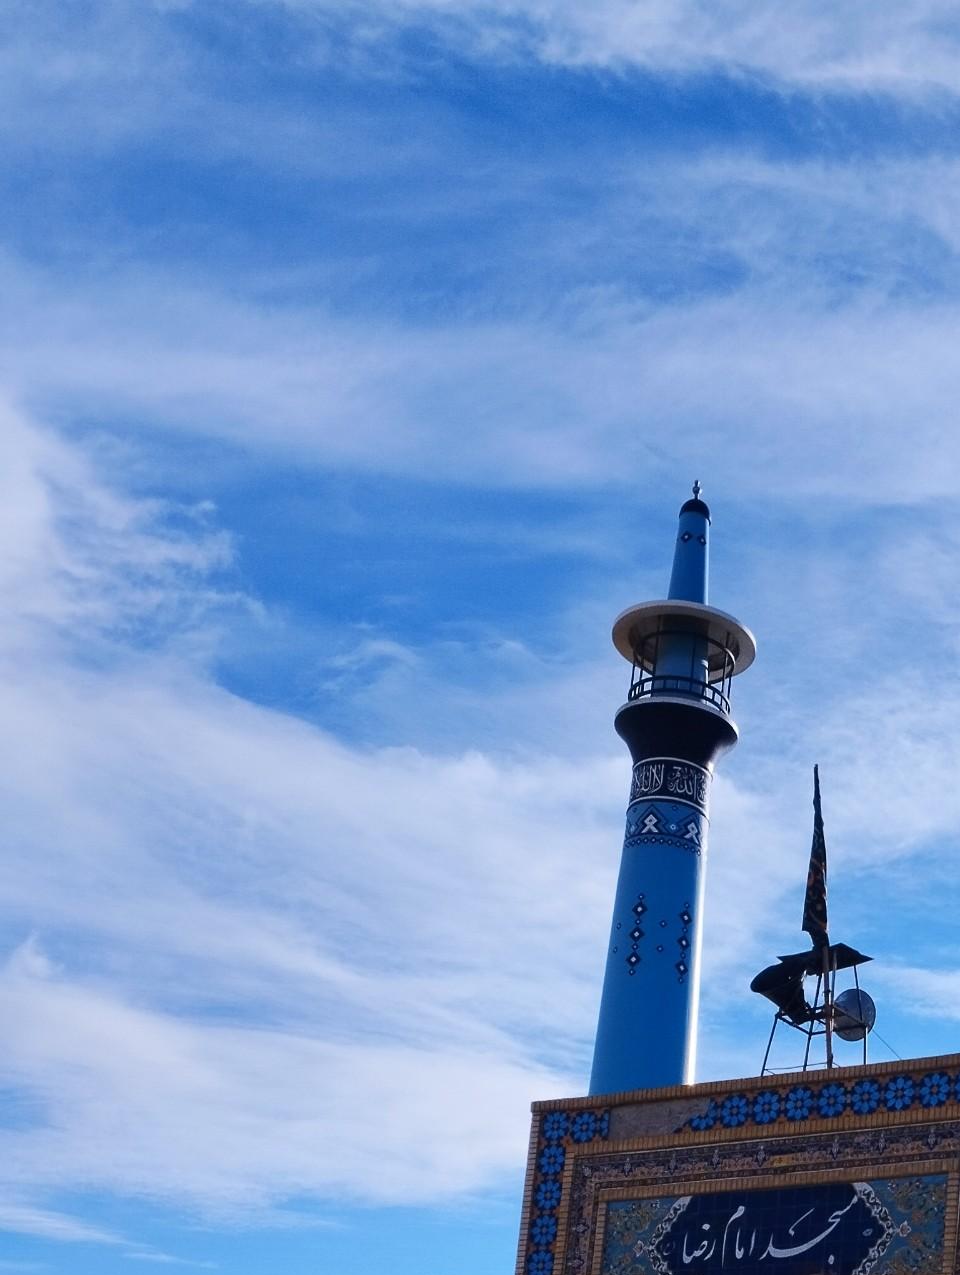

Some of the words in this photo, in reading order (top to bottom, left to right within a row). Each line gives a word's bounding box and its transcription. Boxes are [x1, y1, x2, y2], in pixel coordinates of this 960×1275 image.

[682, 1223, 717, 1264] رضا
[721, 1205, 757, 1269] امام
[758, 1195, 858, 1265] مسجد
